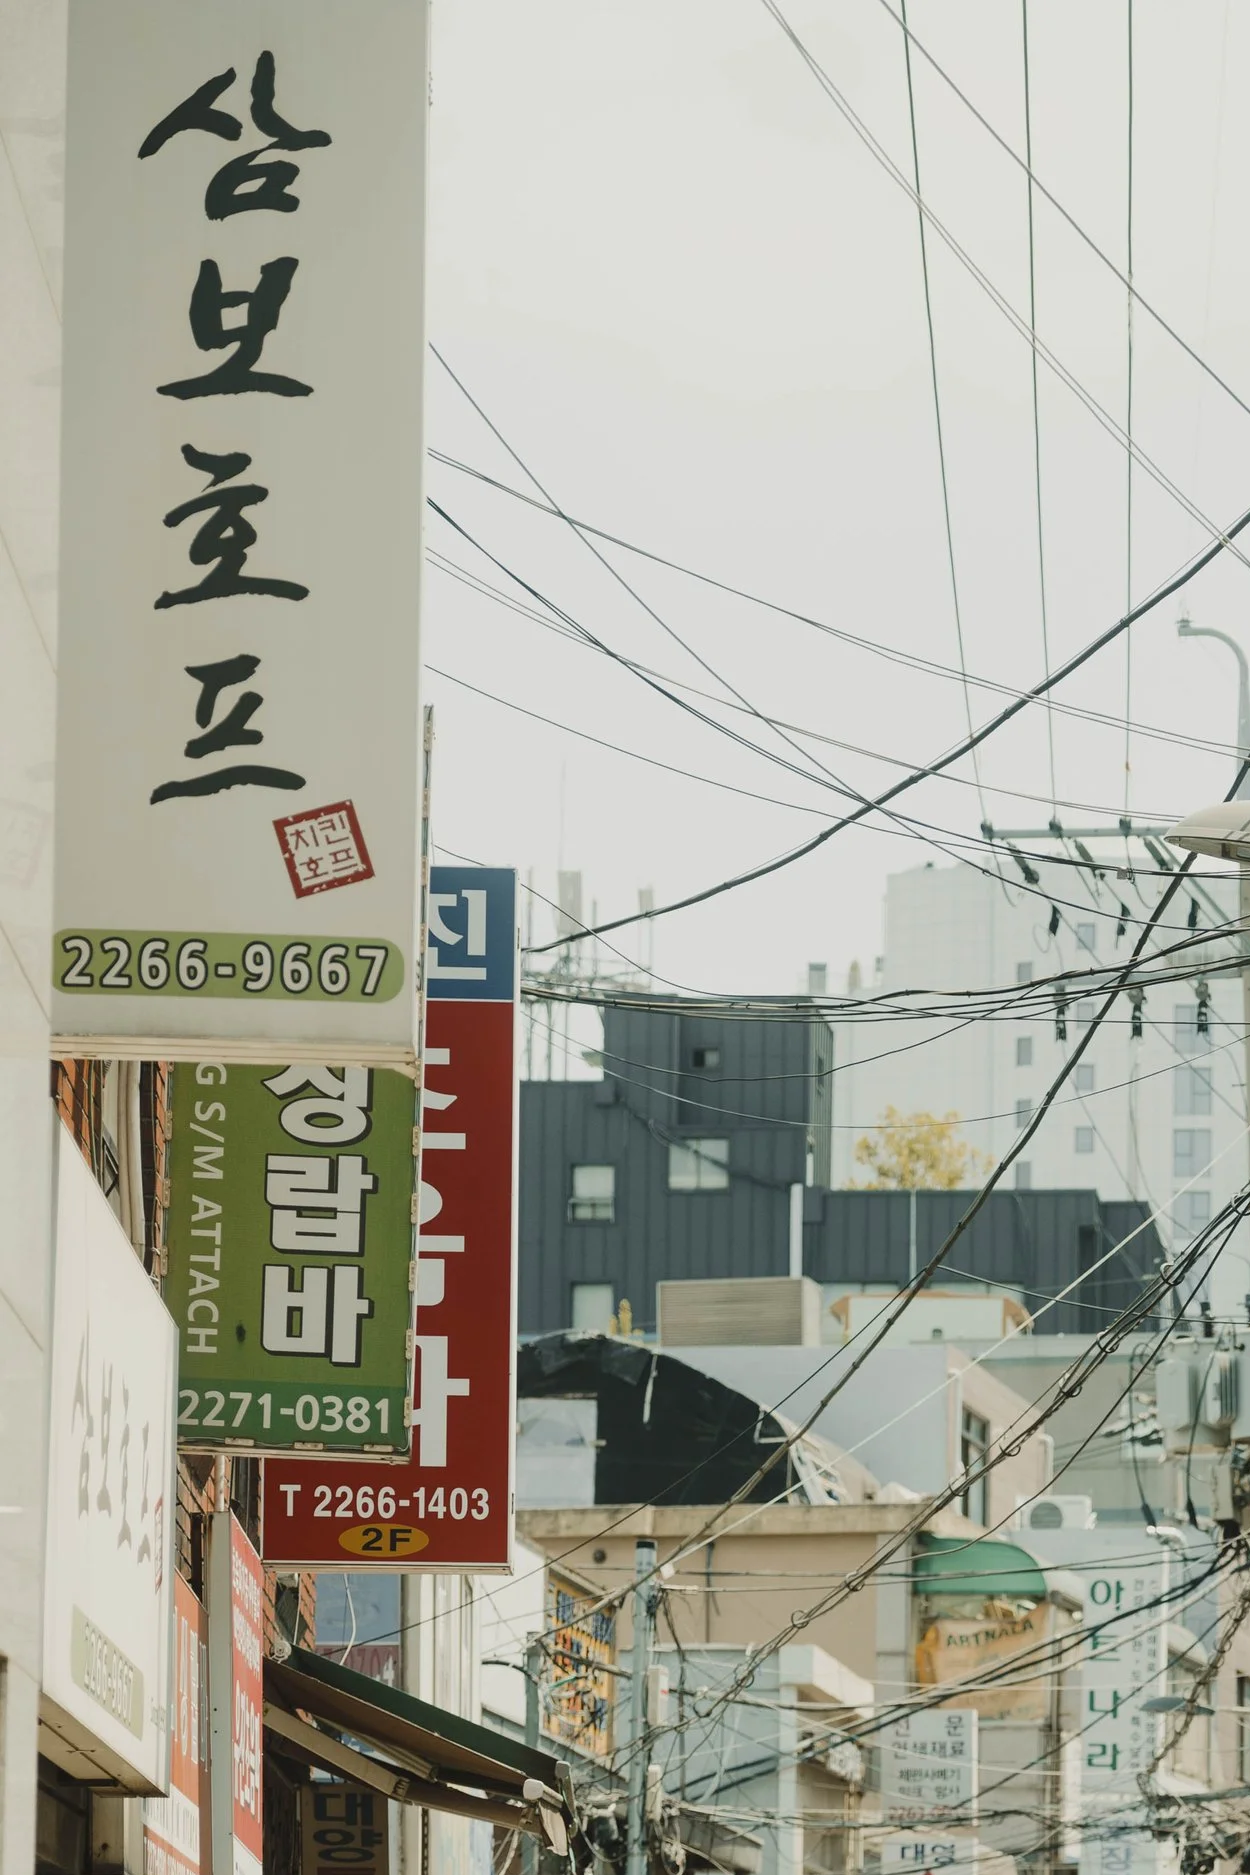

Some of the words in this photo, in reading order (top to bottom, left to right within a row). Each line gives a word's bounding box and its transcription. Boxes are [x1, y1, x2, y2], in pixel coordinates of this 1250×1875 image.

[138, 50, 333, 806] 삼보호프
[287, 807, 351, 851] 치킨
[299, 845, 360, 884] 호프
[60, 936, 389, 996] 2266-9667
[186, 1195, 223, 1355] ATTACH
[178, 1390, 390, 1435] 2271-0381
[312, 1485, 490, 1521] 2266-1403
[361, 1526, 412, 1553] 2F
